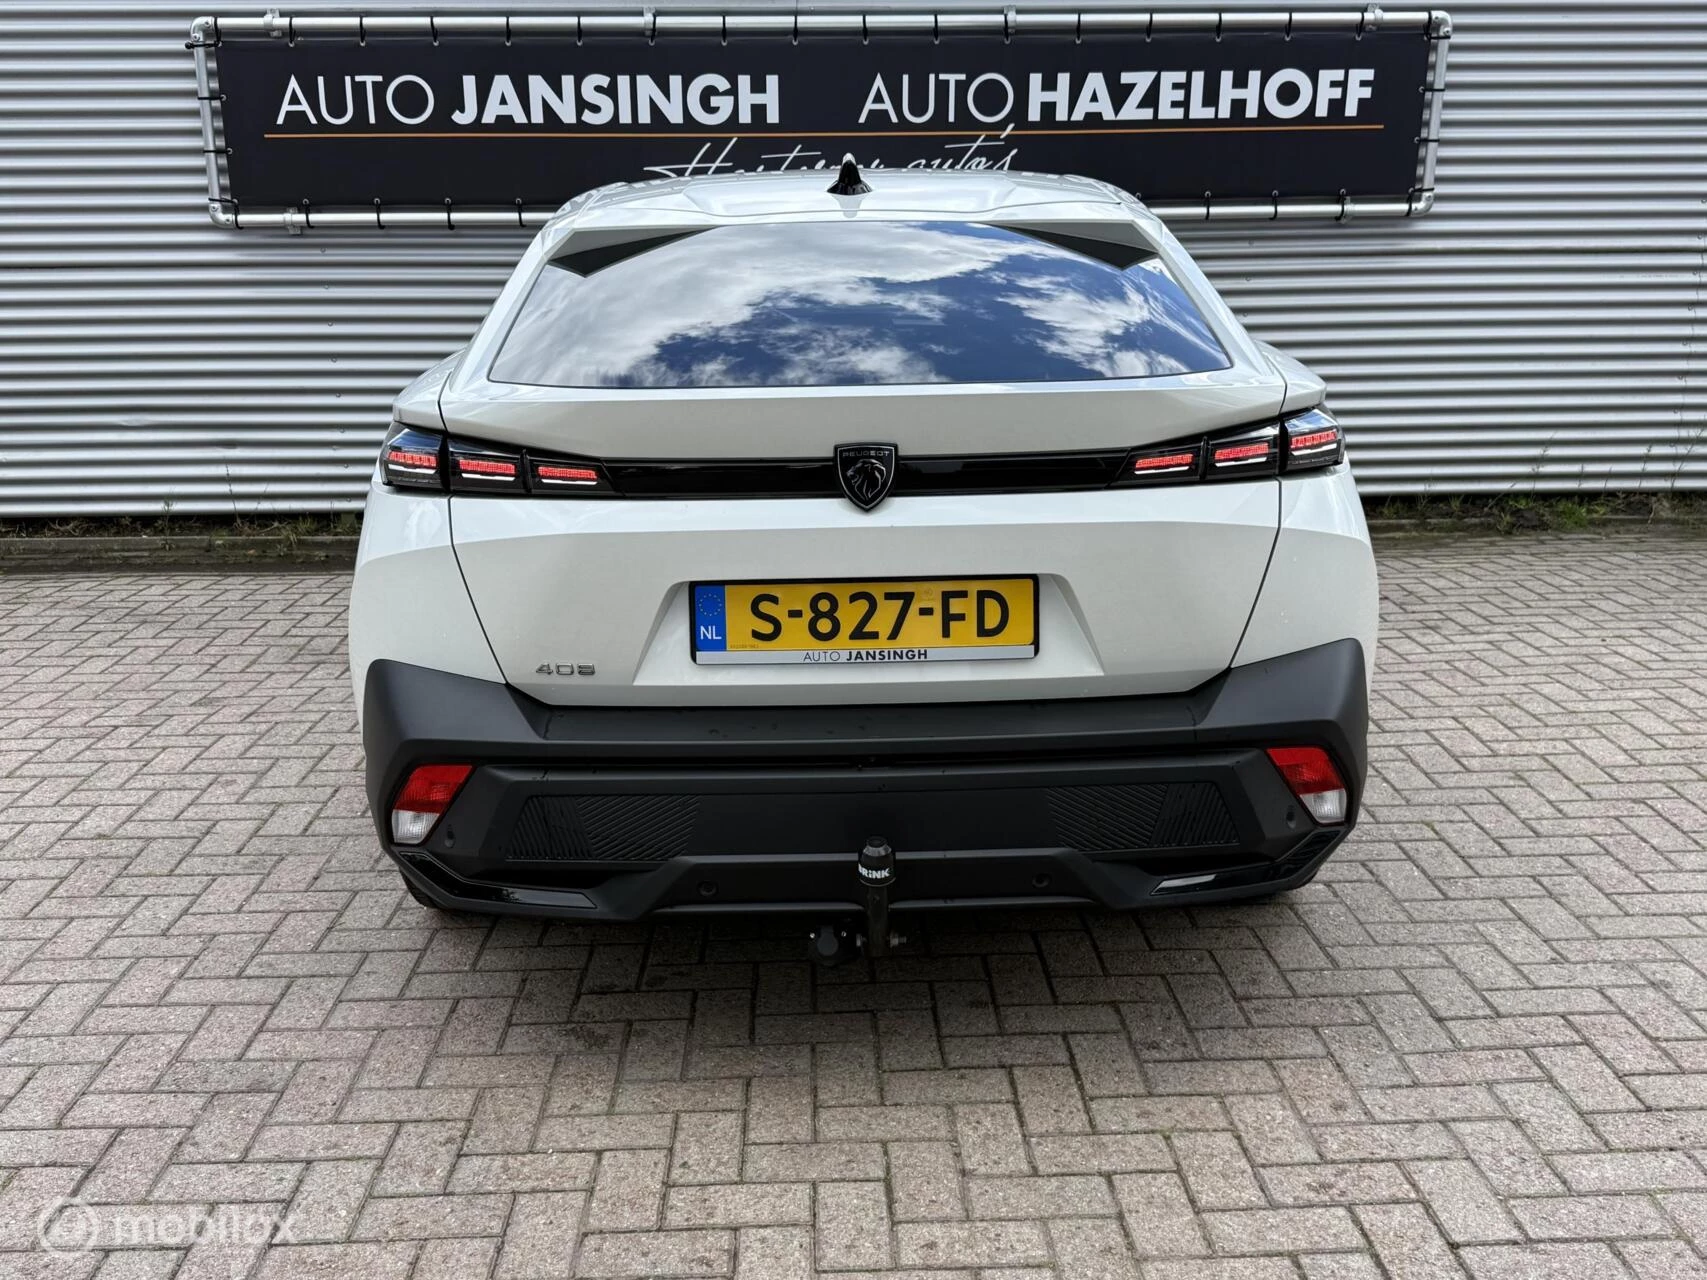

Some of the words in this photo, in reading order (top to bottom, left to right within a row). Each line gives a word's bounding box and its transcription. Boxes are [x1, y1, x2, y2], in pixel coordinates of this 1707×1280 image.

[276, 74, 434, 125] AUTO
[451, 74, 779, 125] JANSINGH
[858, 72, 1014, 123] AUTO
[1027, 69, 1374, 122] HAZELHOFF
[750, 589, 1010, 642] S-827-FD
[700, 625, 722, 640] NL
[536, 663, 595, 675] 408
[803, 651, 840, 662] AUTO
[846, 649, 928, 661] JANSINGH
